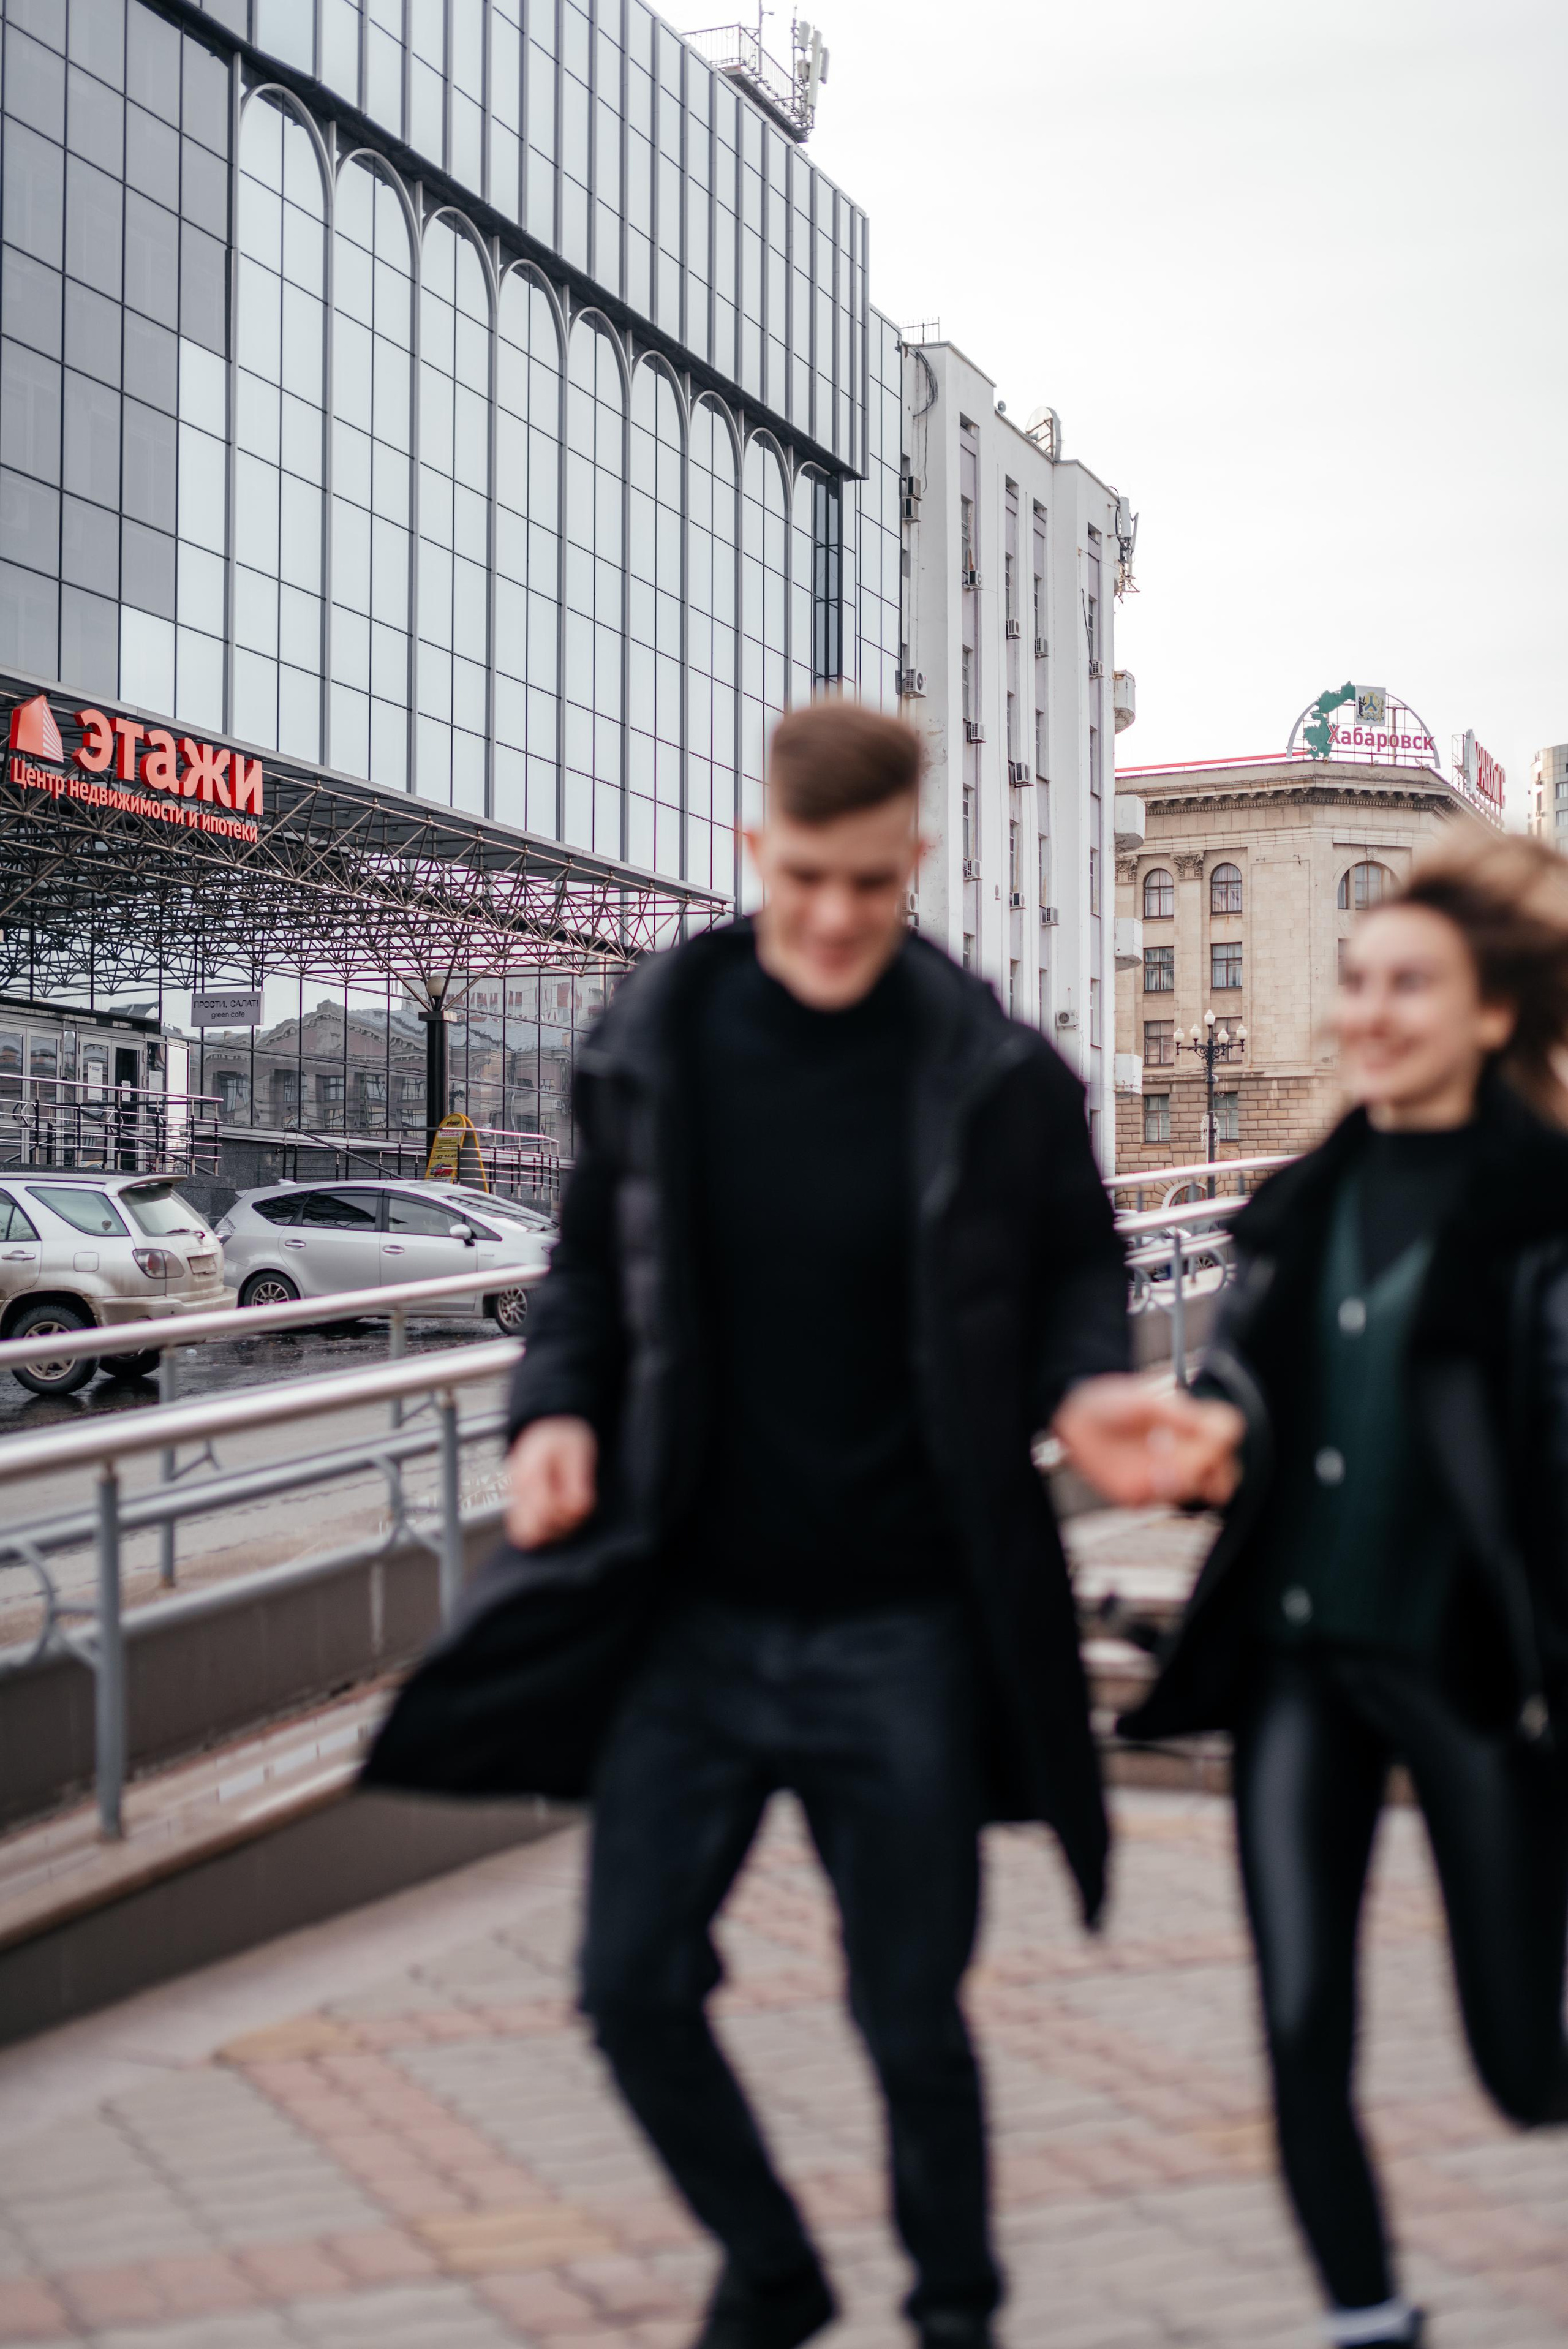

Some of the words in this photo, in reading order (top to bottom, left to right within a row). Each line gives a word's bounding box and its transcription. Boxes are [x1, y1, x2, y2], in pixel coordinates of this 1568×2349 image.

[1327, 724, 1435, 752] Хабаровск
[11, 758, 65, 799] Центр
[67, 779, 184, 825] недвижимости
[186, 811, 198, 828] и
[199, 813, 258, 843] ипотеки
